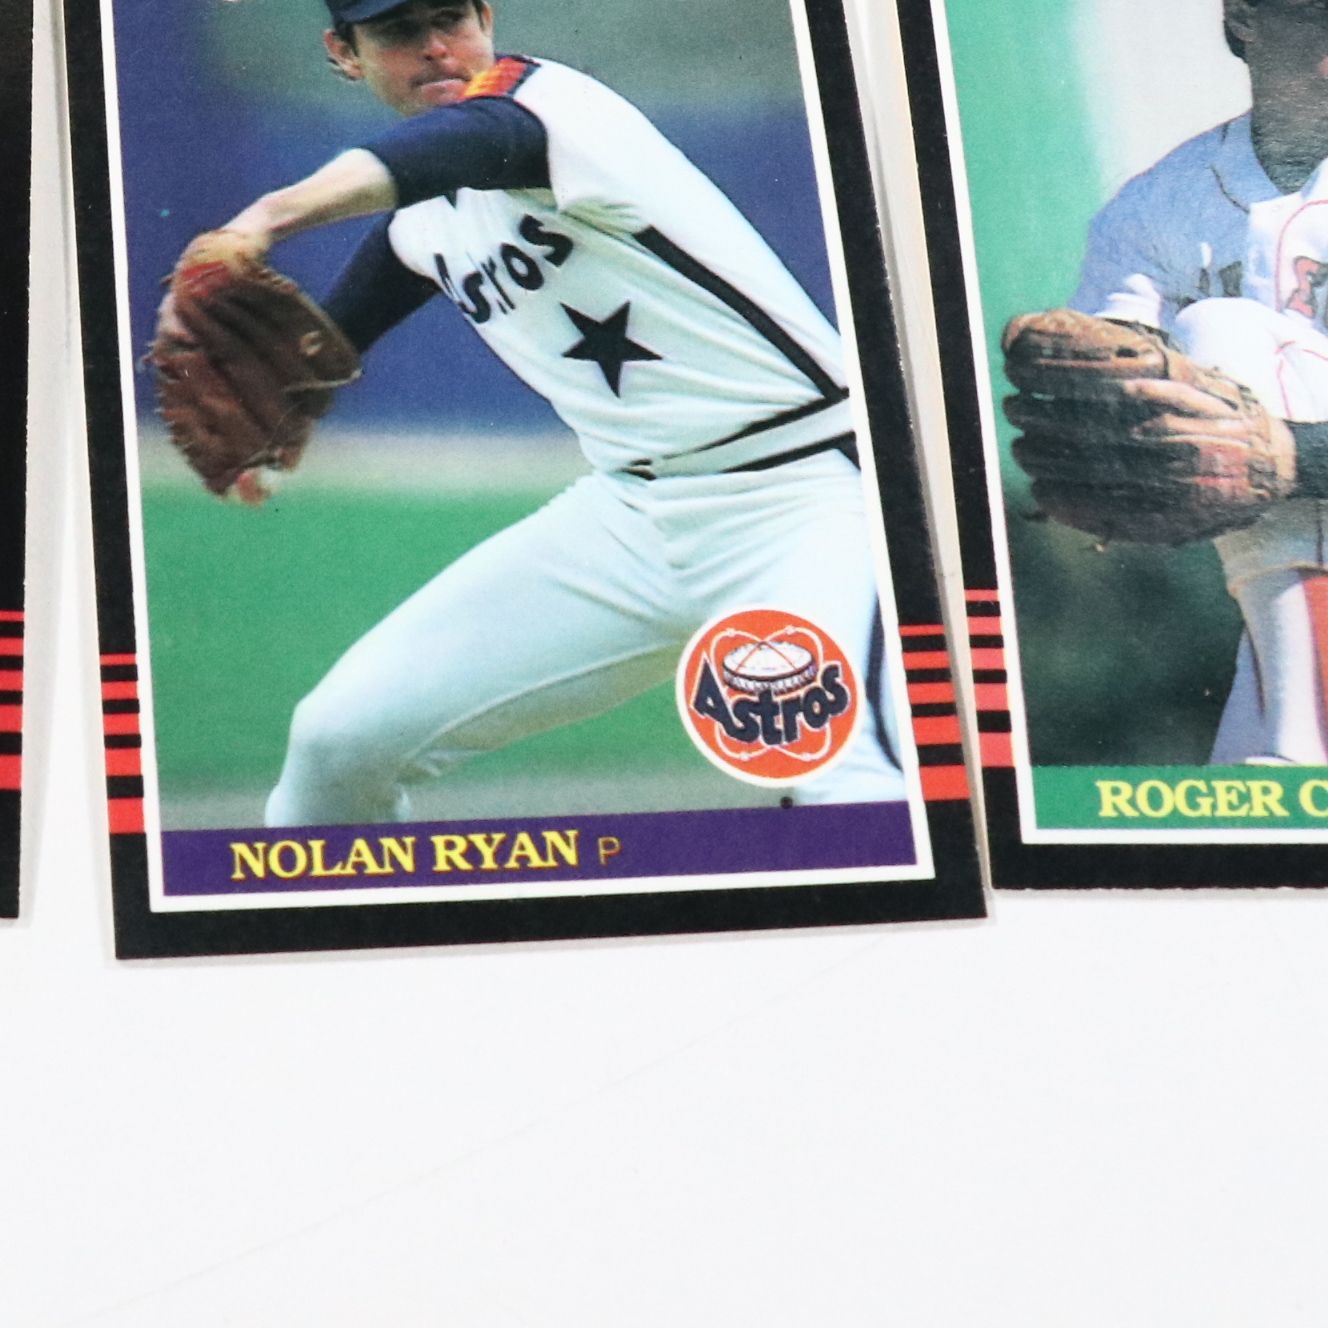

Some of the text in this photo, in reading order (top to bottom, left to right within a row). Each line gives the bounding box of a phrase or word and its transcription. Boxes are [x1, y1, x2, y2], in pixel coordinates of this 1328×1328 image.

[691, 650, 851, 748] Astros
[1095, 778, 1290, 819] ROGER
[229, 829, 622, 881] NOLAN RYAN P
